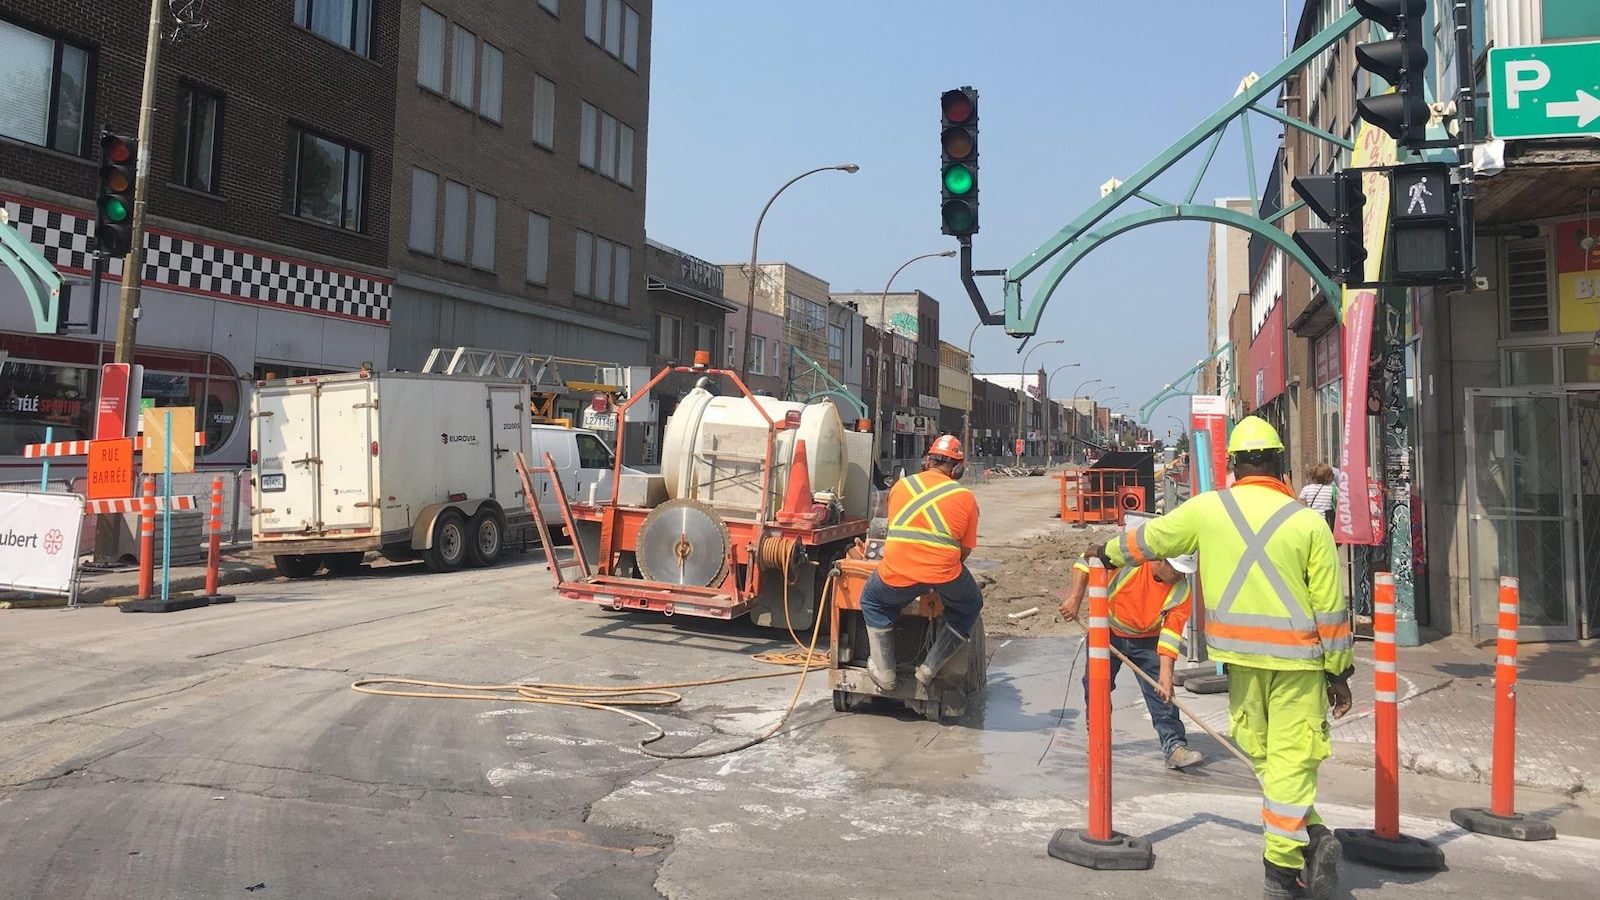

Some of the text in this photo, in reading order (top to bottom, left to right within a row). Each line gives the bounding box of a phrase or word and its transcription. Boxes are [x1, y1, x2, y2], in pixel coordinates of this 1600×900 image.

[1505, 60, 1551, 109] P
[17, 394, 39, 412] TÉLÉ
[449, 435, 477, 443] EUROVIA
[102, 448, 119, 462] RUE
[92, 467, 127, 484] BARRÉE
